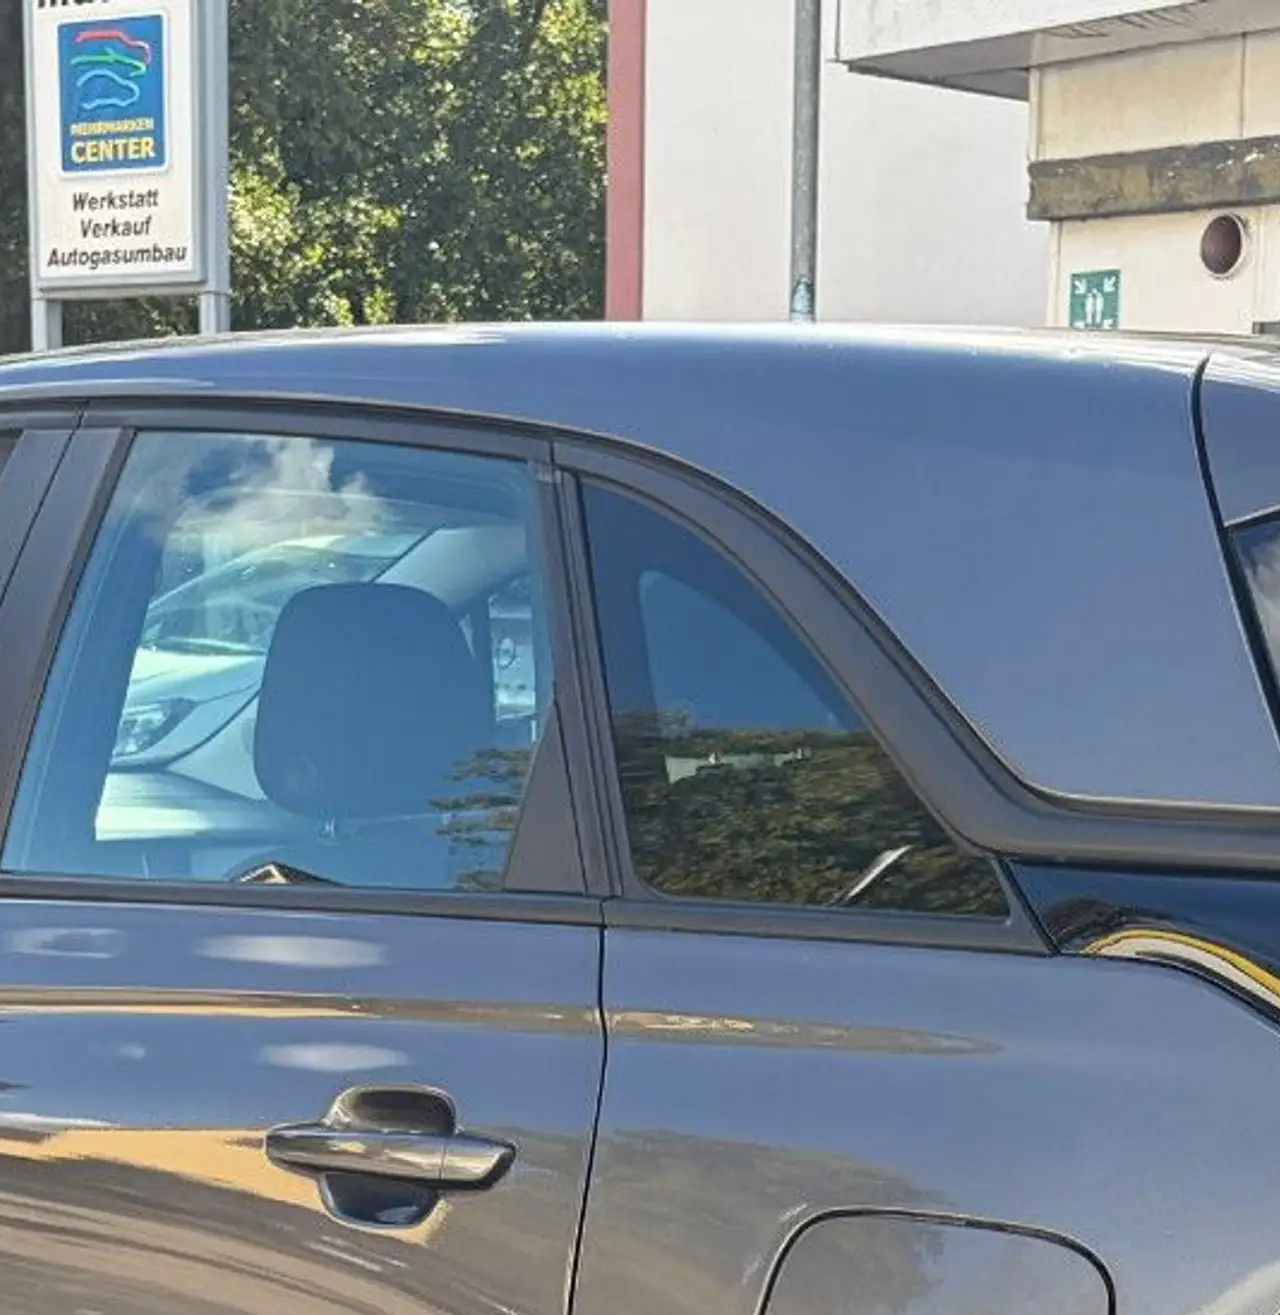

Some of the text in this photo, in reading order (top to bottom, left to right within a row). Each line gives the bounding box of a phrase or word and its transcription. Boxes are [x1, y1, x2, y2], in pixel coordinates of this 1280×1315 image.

[70, 137, 156, 164] CENTER
[72, 188, 160, 213] Werkstatt
[80, 216, 153, 239] Verkauf
[47, 243, 188, 270] Autogasumbau
